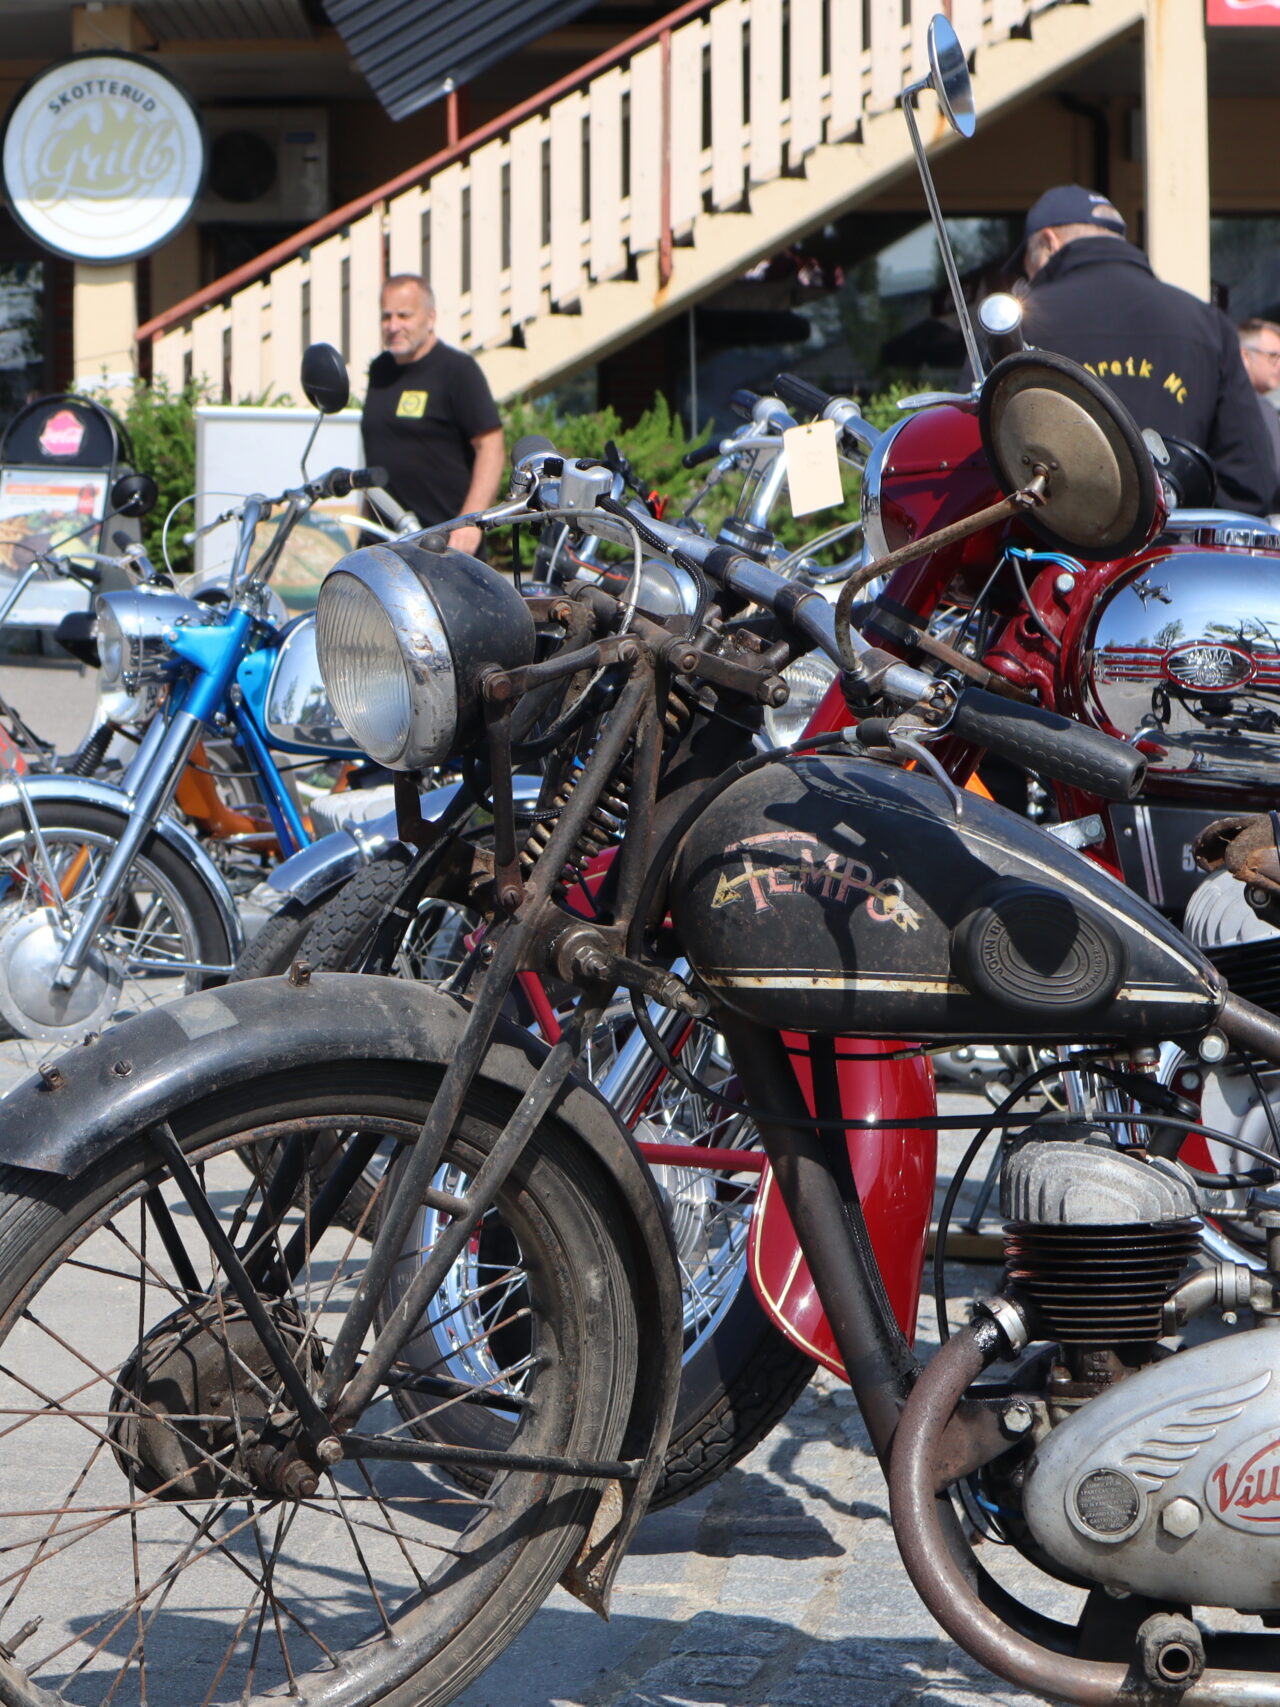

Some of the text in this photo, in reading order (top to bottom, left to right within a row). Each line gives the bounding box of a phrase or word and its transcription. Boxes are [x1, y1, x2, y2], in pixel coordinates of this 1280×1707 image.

[48, 79, 156, 115] SKOTTERUD
[31, 119, 175, 209] Grill
[723, 830, 904, 921] TEMPO
[984, 938, 1004, 977] JOHN
[1212, 1439, 1280, 1512] Vill
